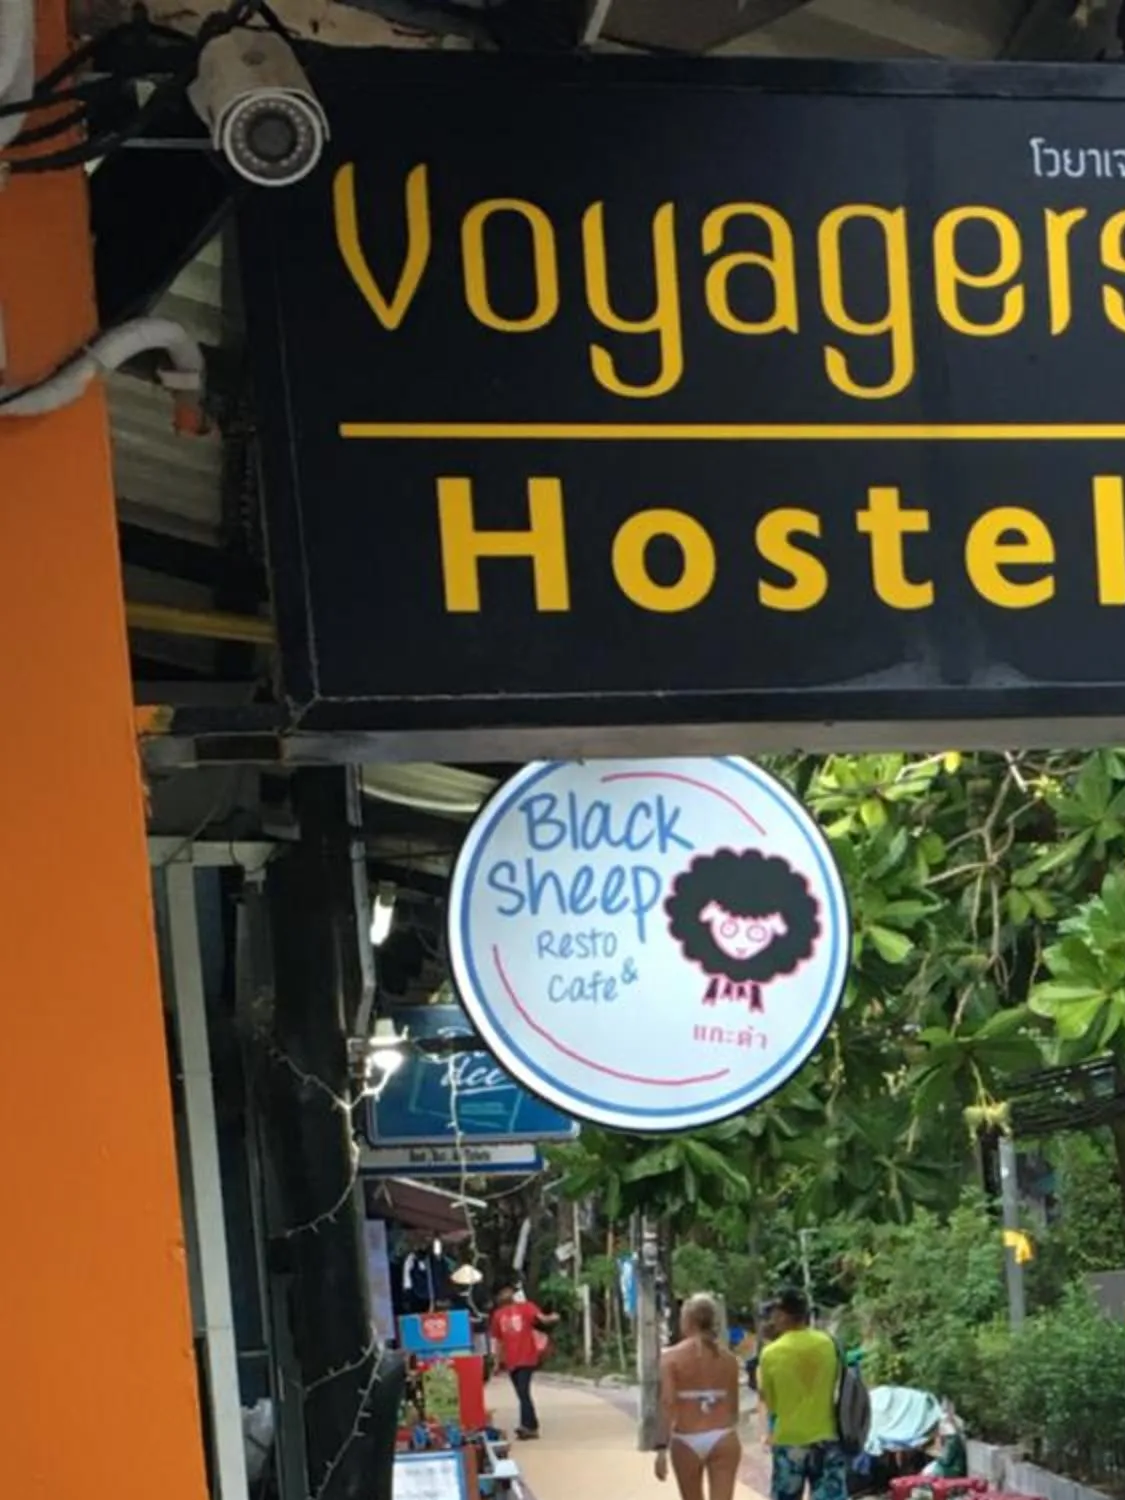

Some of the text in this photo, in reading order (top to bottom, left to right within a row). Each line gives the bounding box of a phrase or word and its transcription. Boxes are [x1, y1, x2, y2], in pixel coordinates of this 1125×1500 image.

[518, 790, 696, 853] Black
[487, 857, 662, 944] Sheep
[536, 928, 618, 960] Resto
